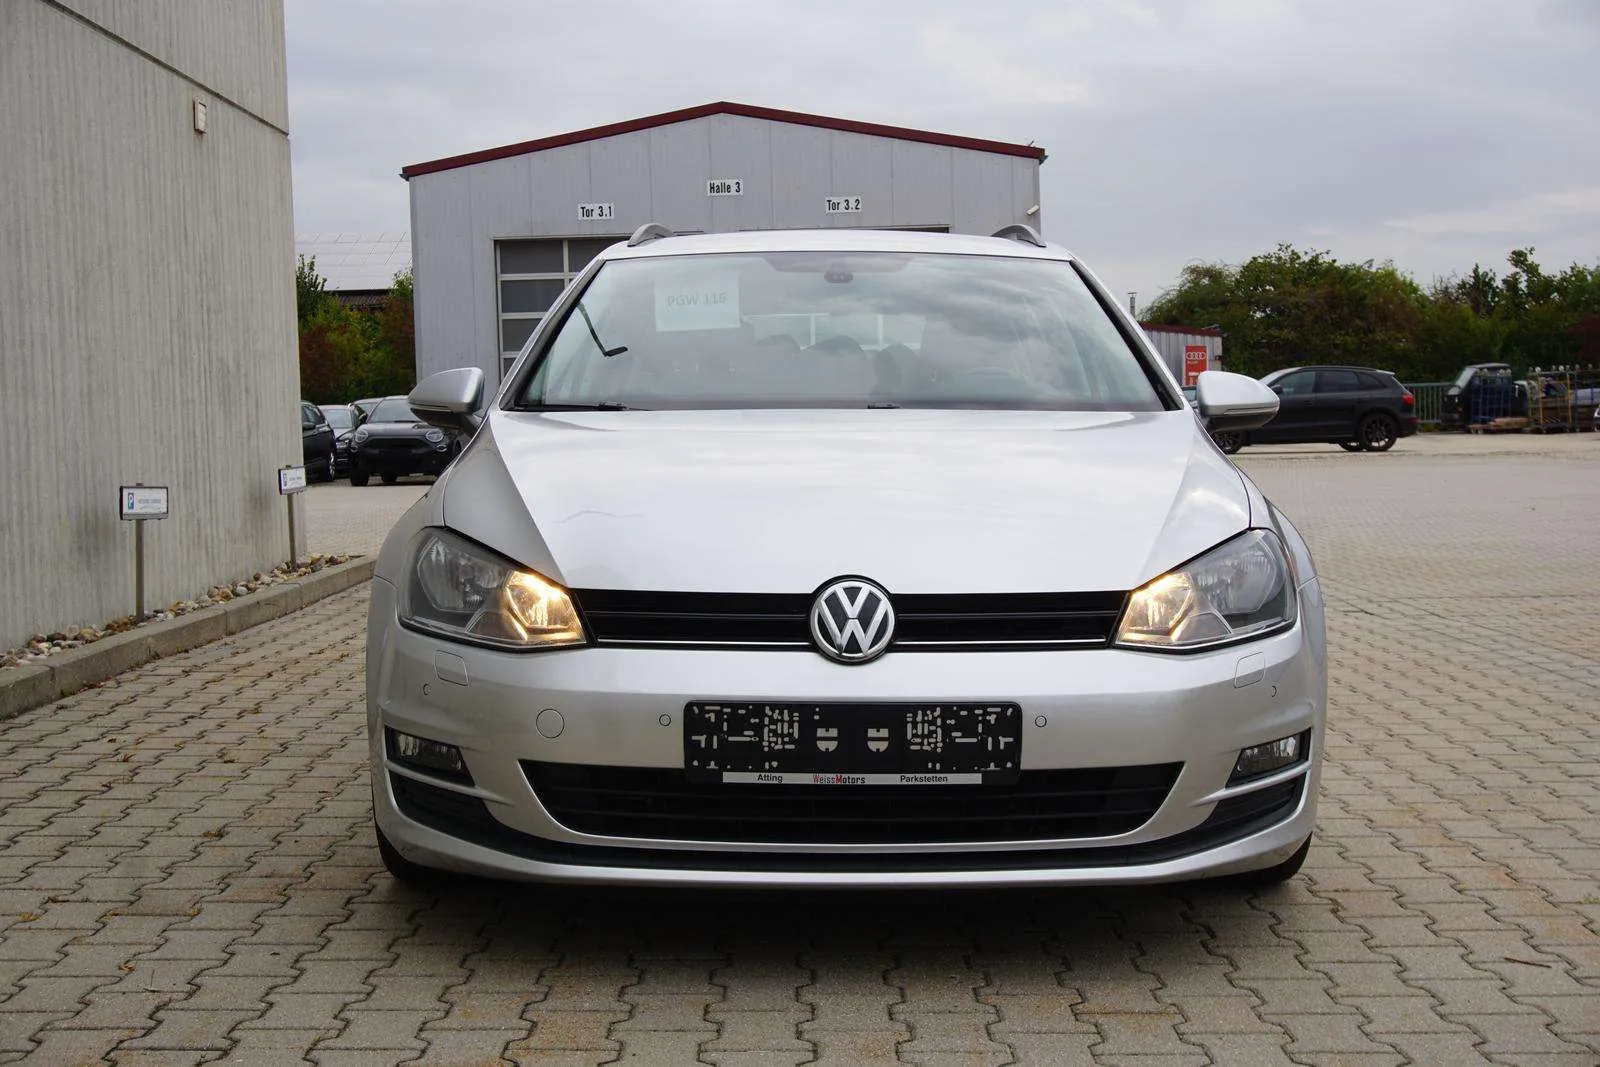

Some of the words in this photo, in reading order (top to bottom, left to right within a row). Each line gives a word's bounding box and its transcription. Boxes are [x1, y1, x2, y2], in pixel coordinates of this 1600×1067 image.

[708, 181, 732, 194] Halle
[735, 181, 742, 193] 3
[580, 206, 595, 218] Tor
[598, 205, 613, 218] 3.1
[826, 199, 841, 212] Tor
[844, 198, 861, 211] 3.2
[667, 293, 699, 307] PGW
[703, 291, 727, 306] 116
[757, 773, 783, 784] Atting
[812, 773, 866, 785] WeissMotors
[900, 774, 949, 784] Parkstetten
